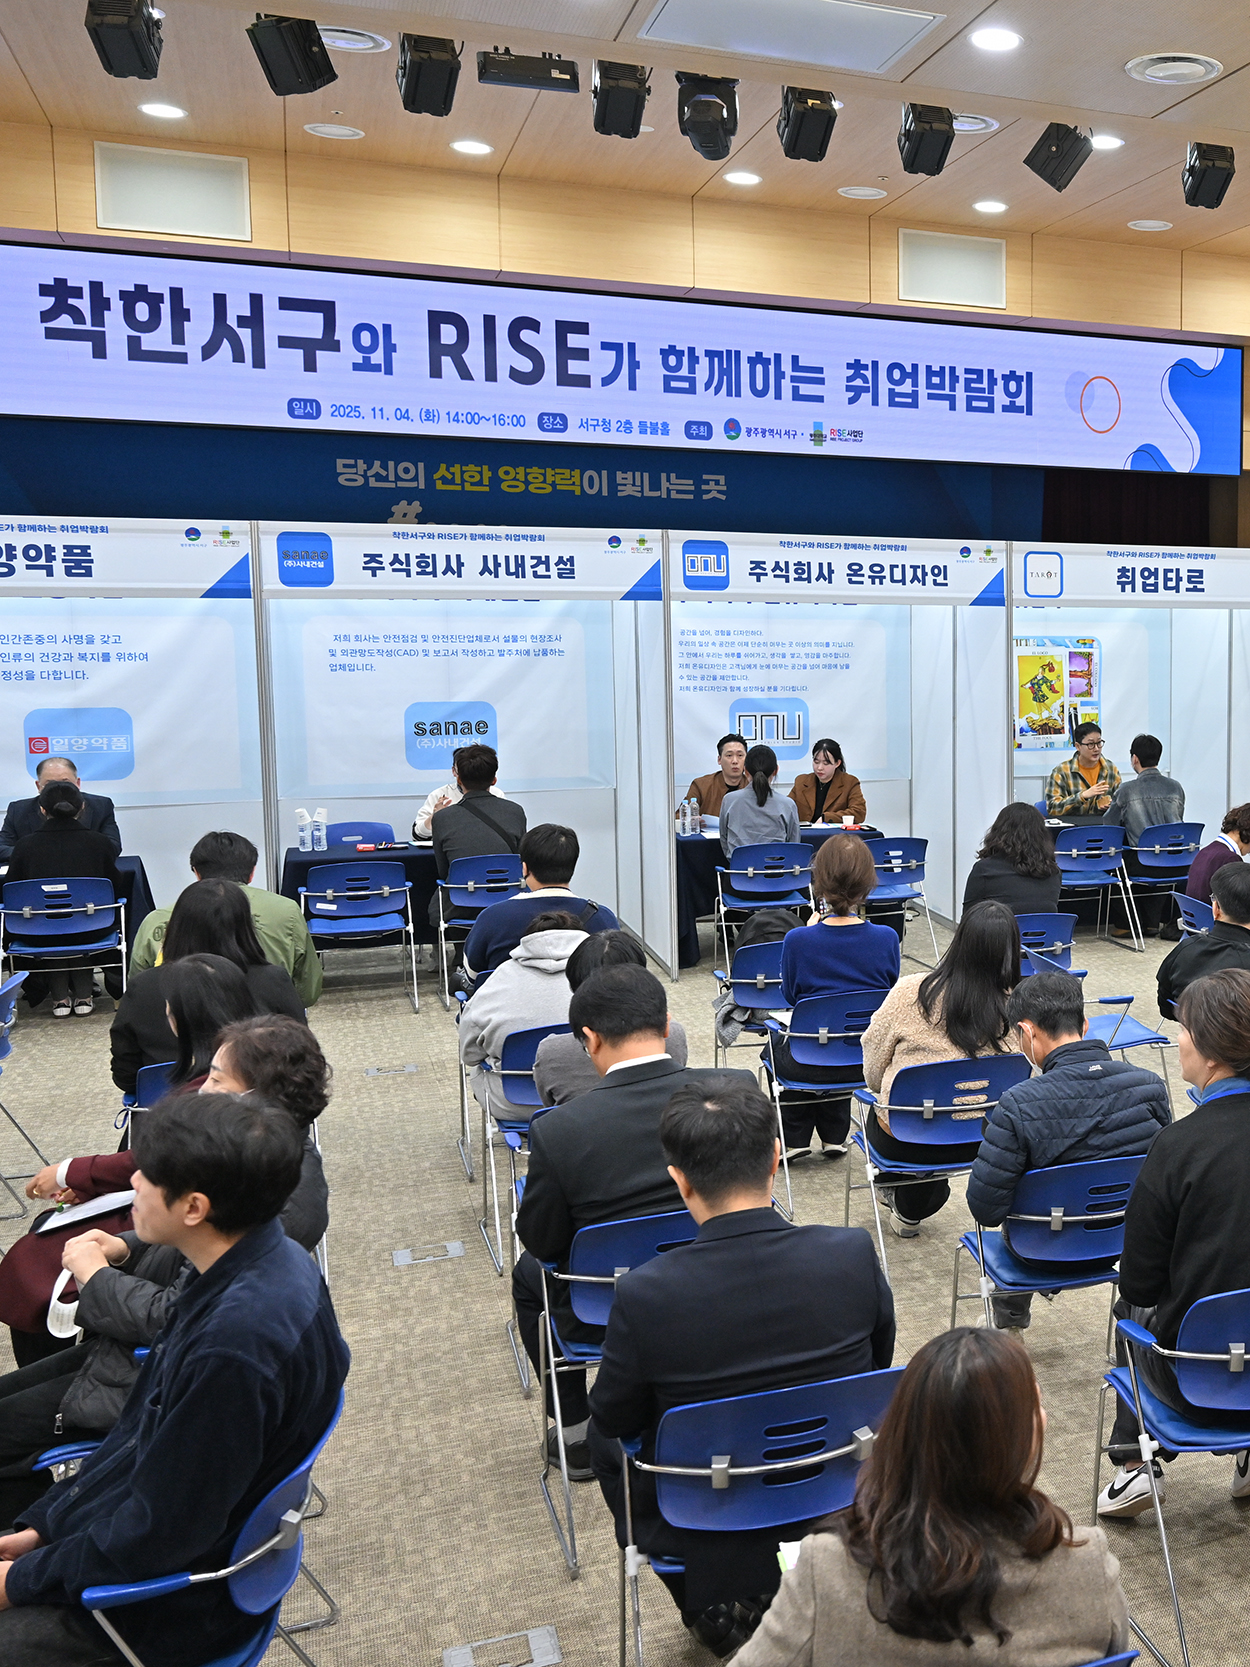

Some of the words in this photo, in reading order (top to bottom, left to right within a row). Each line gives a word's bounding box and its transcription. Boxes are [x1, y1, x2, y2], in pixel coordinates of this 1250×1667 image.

[38, 276, 398, 376] 착한서구와
[426, 308, 641, 391] RISE가
[659, 344, 826, 403] 함께하는
[845, 359, 1034, 416] 취업박람회
[292, 401, 316, 416] 일시
[330, 404, 365, 420] 2025.
[371, 407, 389, 421] 11.
[394, 408, 414, 422] 04.
[419, 408, 440, 424] (화)
[446, 411, 526, 427] 14:00~16:00
[542, 415, 564, 429] 장소
[578, 418, 612, 433] 서구청
[616, 419, 634, 435] 2층
[637, 420, 671, 436] 들불홀
[690, 425, 709, 437] 주최
[745, 427, 782, 439] 광주광역시
[783, 428, 797, 440] 서구
[830, 428, 863, 438] RISE사업단
[336, 459, 425, 489] 당신의
[433, 463, 492, 492] 선한
[498, 465, 608, 497] 영향력이
[616, 470, 695, 499] 빛나는
[701, 474, 727, 500] 곳
[17, 523, 57, 533] 함께하는
[60, 524, 109, 534] 취업박람회
[392, 531, 435, 540] 착한서구와
[437, 532, 467, 541] RISE가
[469, 533, 502, 542] 함께하는
[504, 534, 545, 542] 취업박람회
[779, 540, 815, 549] 착한서구와
[816, 542, 842, 550] RISE가
[843, 542, 872, 551] 함께하는
[872, 544, 908, 552] 취업박람회
[282, 549, 329, 560] sanae
[1106, 550, 1137, 558] 착한서구와
[1161, 552, 1186, 560] 함께하는
[284, 560, 325, 568] (주)사내건설
[362, 553, 464, 578] 주식회사
[479, 554, 576, 580] 사내건설
[748, 560, 835, 584] 주식회사
[846, 562, 949, 587] 온유디자인
[1116, 566, 1205, 594] 취업타로
[0, 634, 57, 645] 인간존중의
[61, 634, 96, 645] 사명을
[99, 634, 122, 645] 갖고
[333, 634, 351, 643] 저희
[354, 634, 380, 643] 회사는
[383, 634, 418, 644] 안전점검
[420, 634, 429, 643] 및
[431, 634, 500, 643] 안전진단업체로서
[530, 634, 562, 643] 현장조사
[0, 652, 35, 663] 인류의
[39, 652, 74, 663] 건강과
[77, 652, 112, 663] 복지를
[115, 652, 149, 662] 위하여
[328, 649, 337, 658] 및
[421, 649, 430, 658] 및
[433, 649, 459, 657] 보고서
[461, 649, 495, 658] 작성하고
[497, 649, 531, 657] 발주처에
[533, 648, 565, 657] 납품하는
[328, 663, 376, 672] 업체입니다.
[1, 670, 35, 681] 정성을
[40, 670, 89, 681] 다합니다.
[413, 719, 489, 736] sanae
[52, 737, 128, 751] 일양약품
